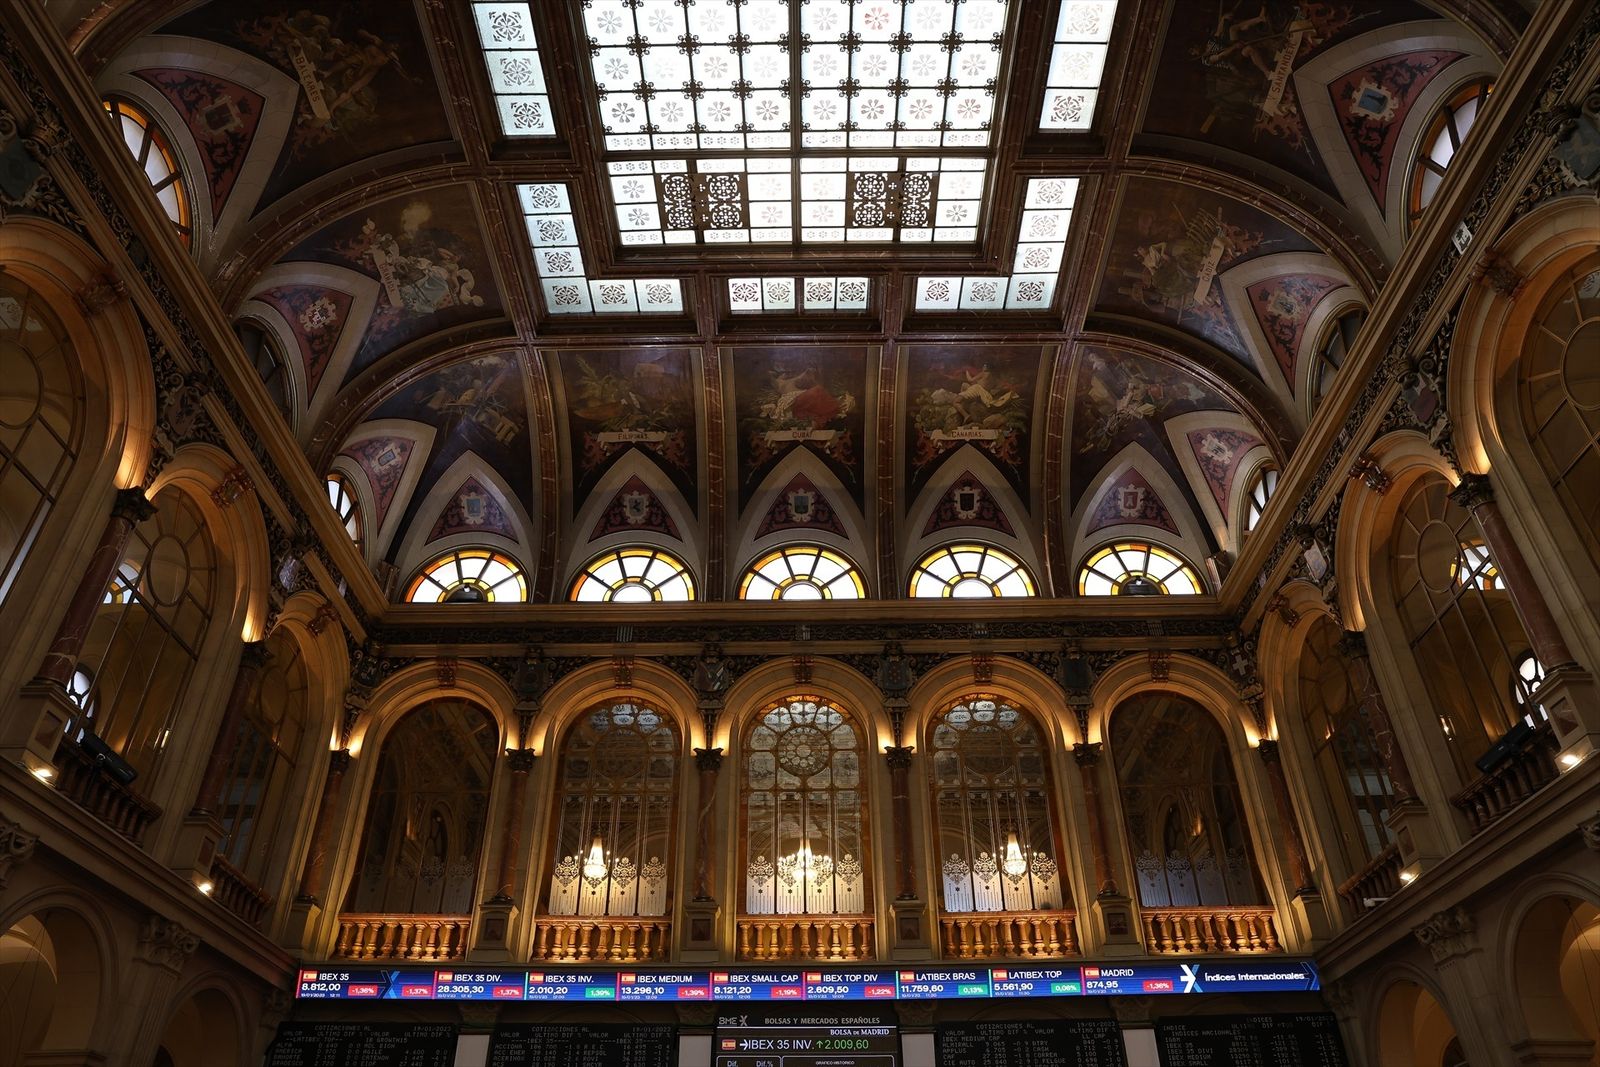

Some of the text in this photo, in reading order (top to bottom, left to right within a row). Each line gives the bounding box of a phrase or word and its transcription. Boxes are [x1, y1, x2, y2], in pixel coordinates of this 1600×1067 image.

[295, 56, 320, 102] BALEARES
[916, 972, 976, 981] LATIBEX BRAS
[1008, 970, 1062, 979] LATIBEX TOP
[1100, 968, 1134, 976] MADRID
[1204, 972, 1236, 981] Índices
[319, 973, 350, 981] IBEX 35
[454, 974, 503, 982] IBEX 35 DIV.
[545, 975, 594, 983] IBEX 35 INV.
[637, 975, 693, 983] IBEX MEDIUM
[729, 975, 750, 983] IBEX
[751, 975, 780, 983] SMALL
[823, 974, 843, 982] IBEX
[844, 974, 862, 982] TOP
[301, 983, 341, 992] 8.812,00
[994, 983, 1033, 991] 5.561,90
[1086, 980, 1119, 989] 874,95
[437, 986, 485, 994] 28.305,30
[528, 986, 568, 995] 2.010,20
[621, 986, 664, 995] 13.296,10
[714, 986, 752, 995] 8.121,20
[807, 986, 849, 994] 2.609,50
[765, 1016, 880, 1025] BOLSAS Y MERCADOS ESPAÑOLES
[830, 1028, 852, 1036] BOLSA
[860, 1028, 890, 1036] MADRID
[748, 1039, 815, 1050] IBEX 35 INV.
[824, 1039, 869, 1051] 2.009,60
